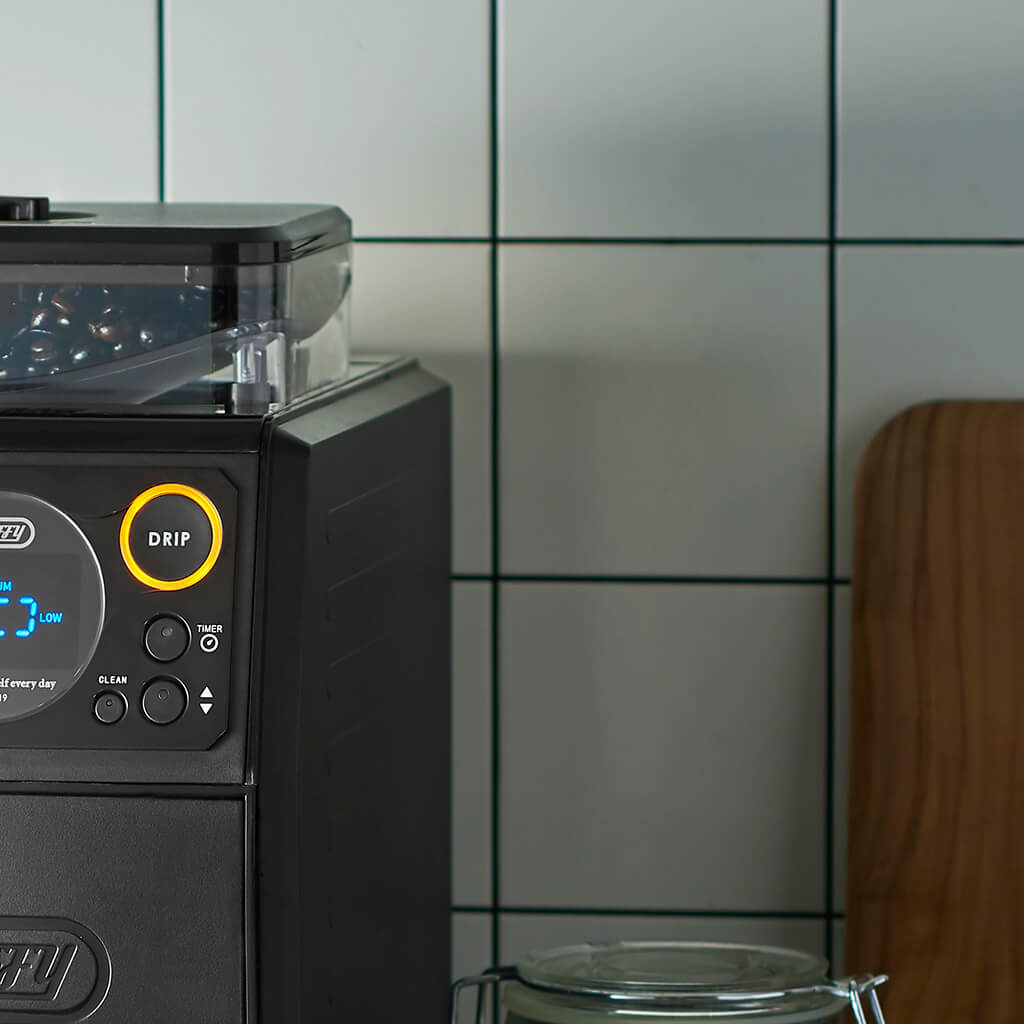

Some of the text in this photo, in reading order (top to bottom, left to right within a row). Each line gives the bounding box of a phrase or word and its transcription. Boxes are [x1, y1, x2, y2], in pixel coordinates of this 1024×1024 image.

[148, 531, 191, 547] DRIP
[38, 612, 63, 624] LOW
[197, 624, 223, 633] TIMER
[11, 680, 36, 690] every
[37, 678, 57, 691] day
[98, 675, 128, 685] CLEAN
